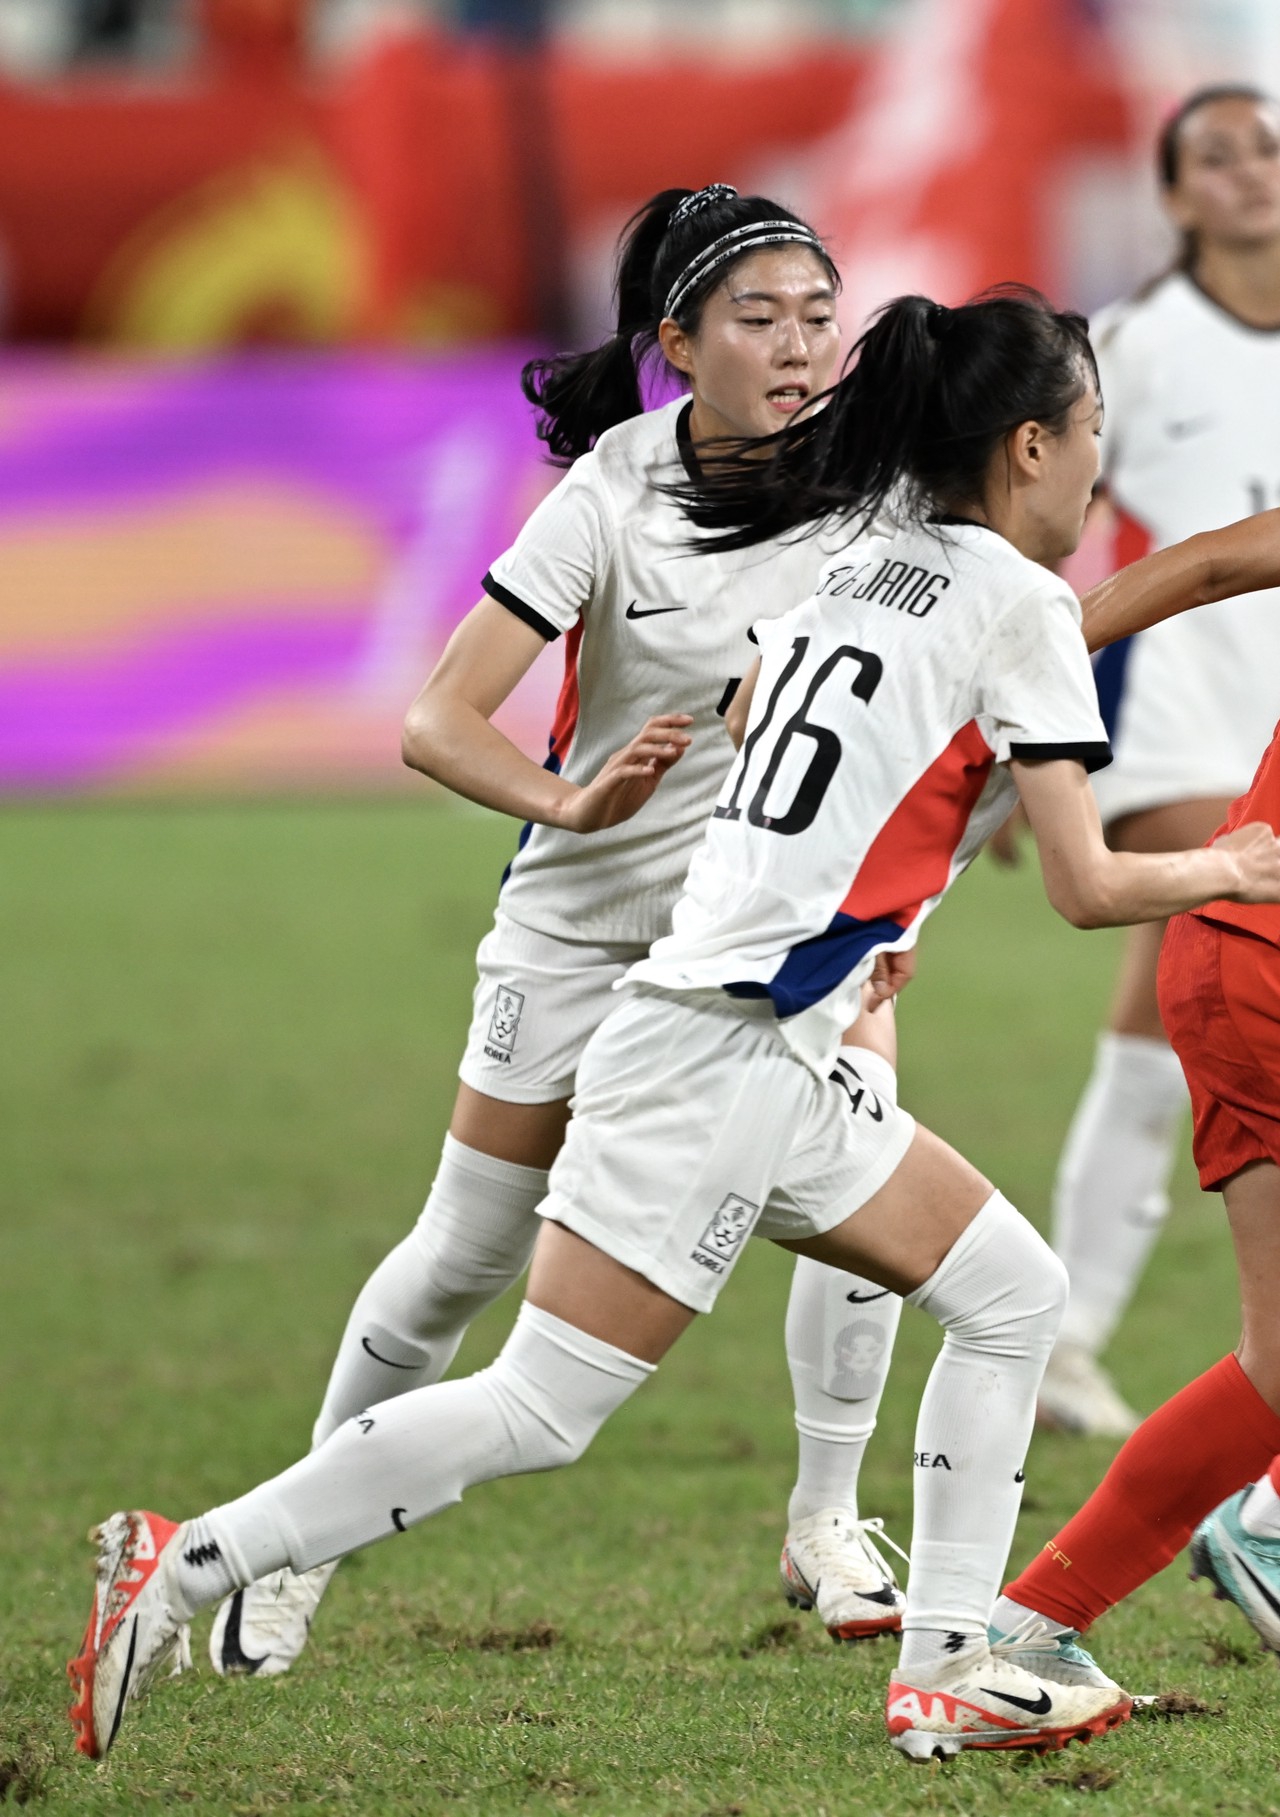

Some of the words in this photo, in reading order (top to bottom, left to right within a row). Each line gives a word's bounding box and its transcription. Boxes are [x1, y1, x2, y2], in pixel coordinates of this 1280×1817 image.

[852, 558, 951, 618] JANG
[713, 636, 883, 836] 16
[483, 1045, 511, 1064] KOREA
